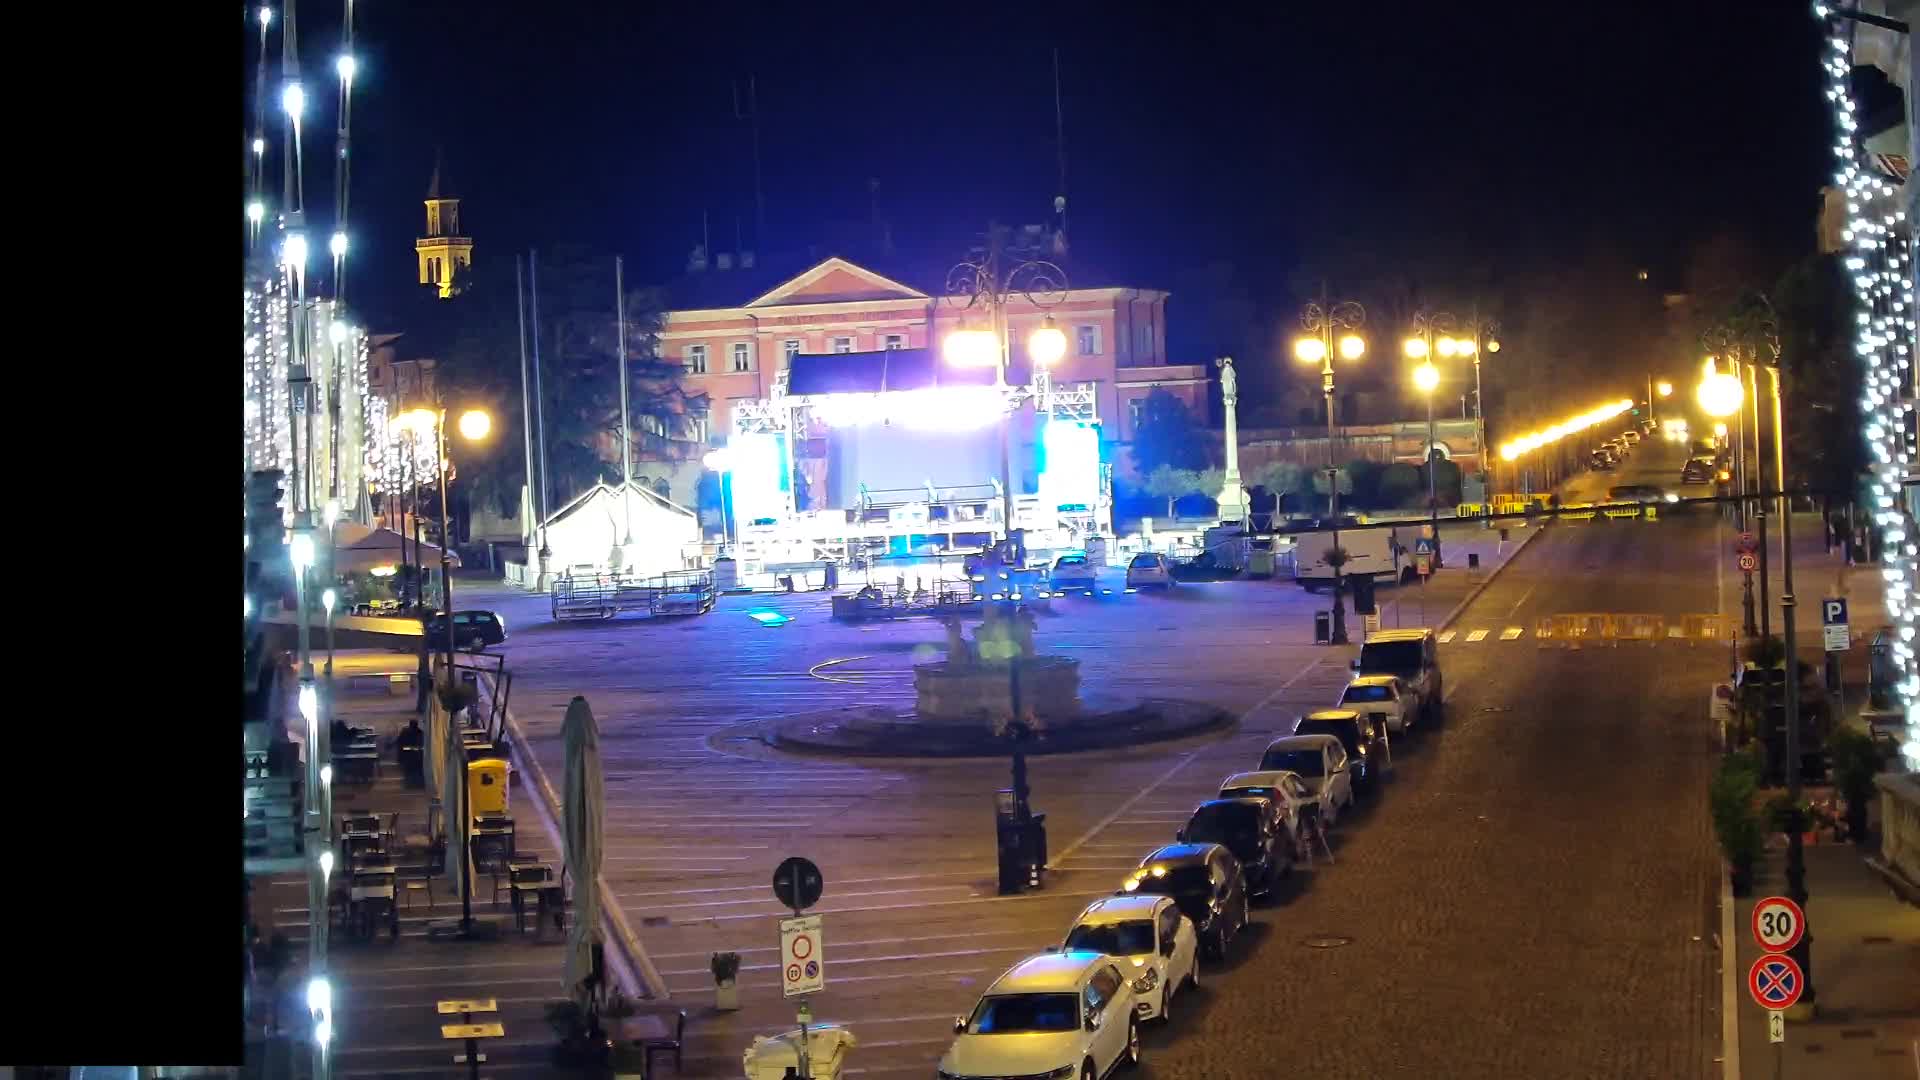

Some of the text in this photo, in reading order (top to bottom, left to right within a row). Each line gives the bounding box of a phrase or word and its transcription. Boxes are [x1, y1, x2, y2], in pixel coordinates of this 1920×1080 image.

[1742, 557, 1753, 567] 20
[1827, 602, 1842, 622] P
[1762, 911, 1791, 937] 30
